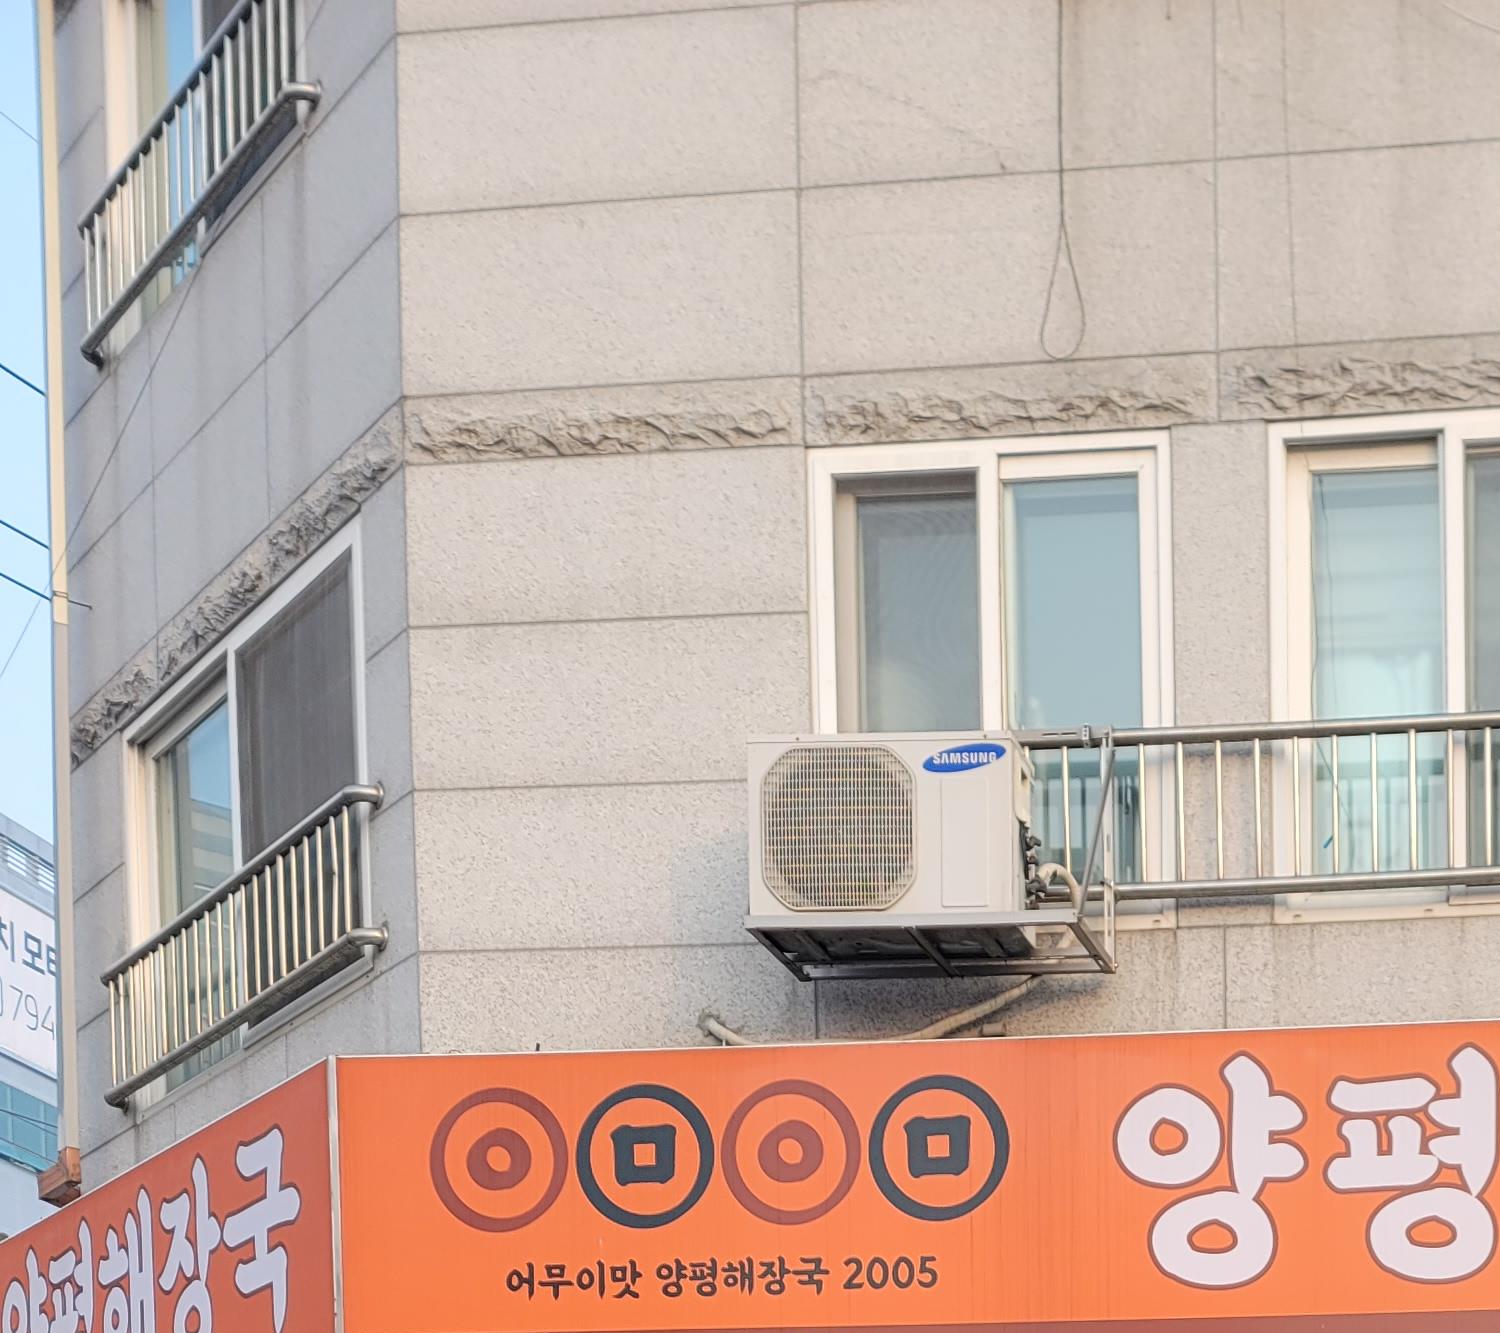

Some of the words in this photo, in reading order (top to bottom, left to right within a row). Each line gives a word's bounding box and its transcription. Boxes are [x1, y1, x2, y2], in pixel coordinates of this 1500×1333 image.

[932, 751, 997, 765] SAMSUNG
[506, 1259, 642, 1300] 어무이맛
[656, 1255, 830, 1297] 양평해장국
[843, 1256, 938, 1291] 2005
